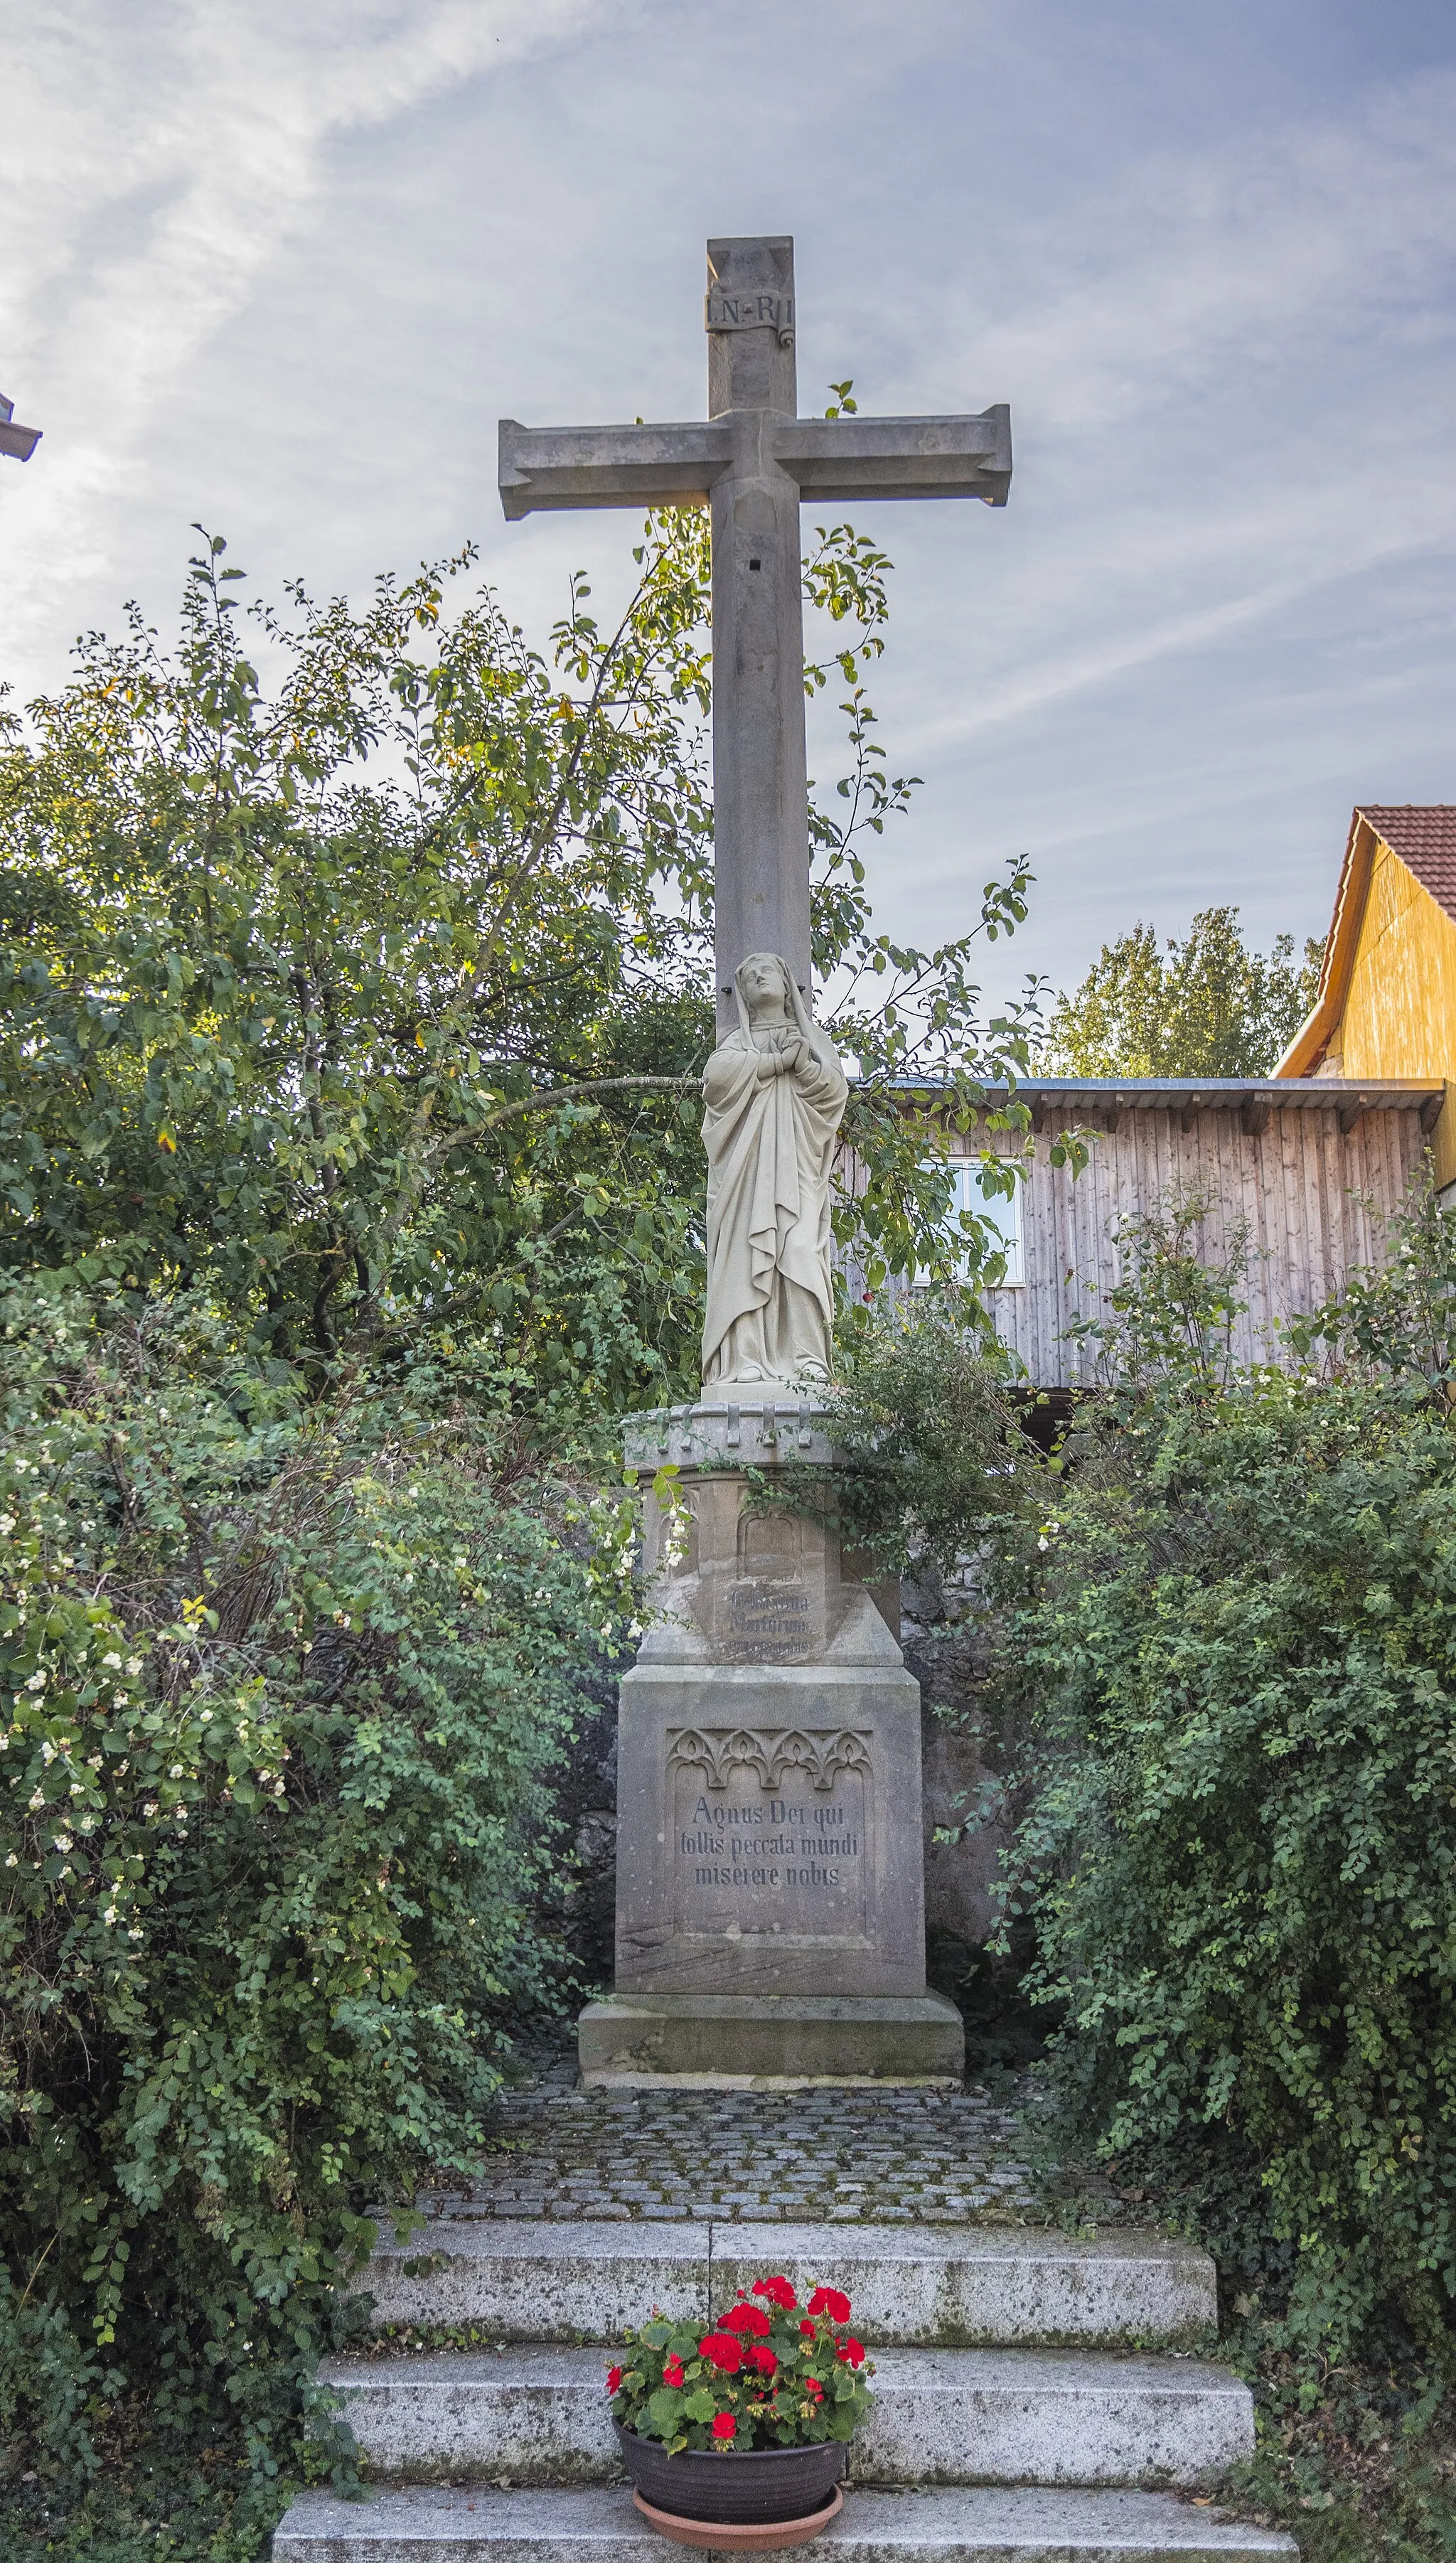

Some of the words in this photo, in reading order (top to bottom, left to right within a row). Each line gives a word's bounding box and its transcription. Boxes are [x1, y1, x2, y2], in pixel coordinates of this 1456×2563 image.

[693, 1797, 763, 1834] Agnus
[771, 1800, 805, 1824] Dei
[814, 1803, 843, 1834] qui
[680, 1831, 724, 1855] tollis
[731, 1832, 795, 1863] peccata
[801, 1833, 857, 1856] mundi
[786, 1861, 840, 1886] nobis
